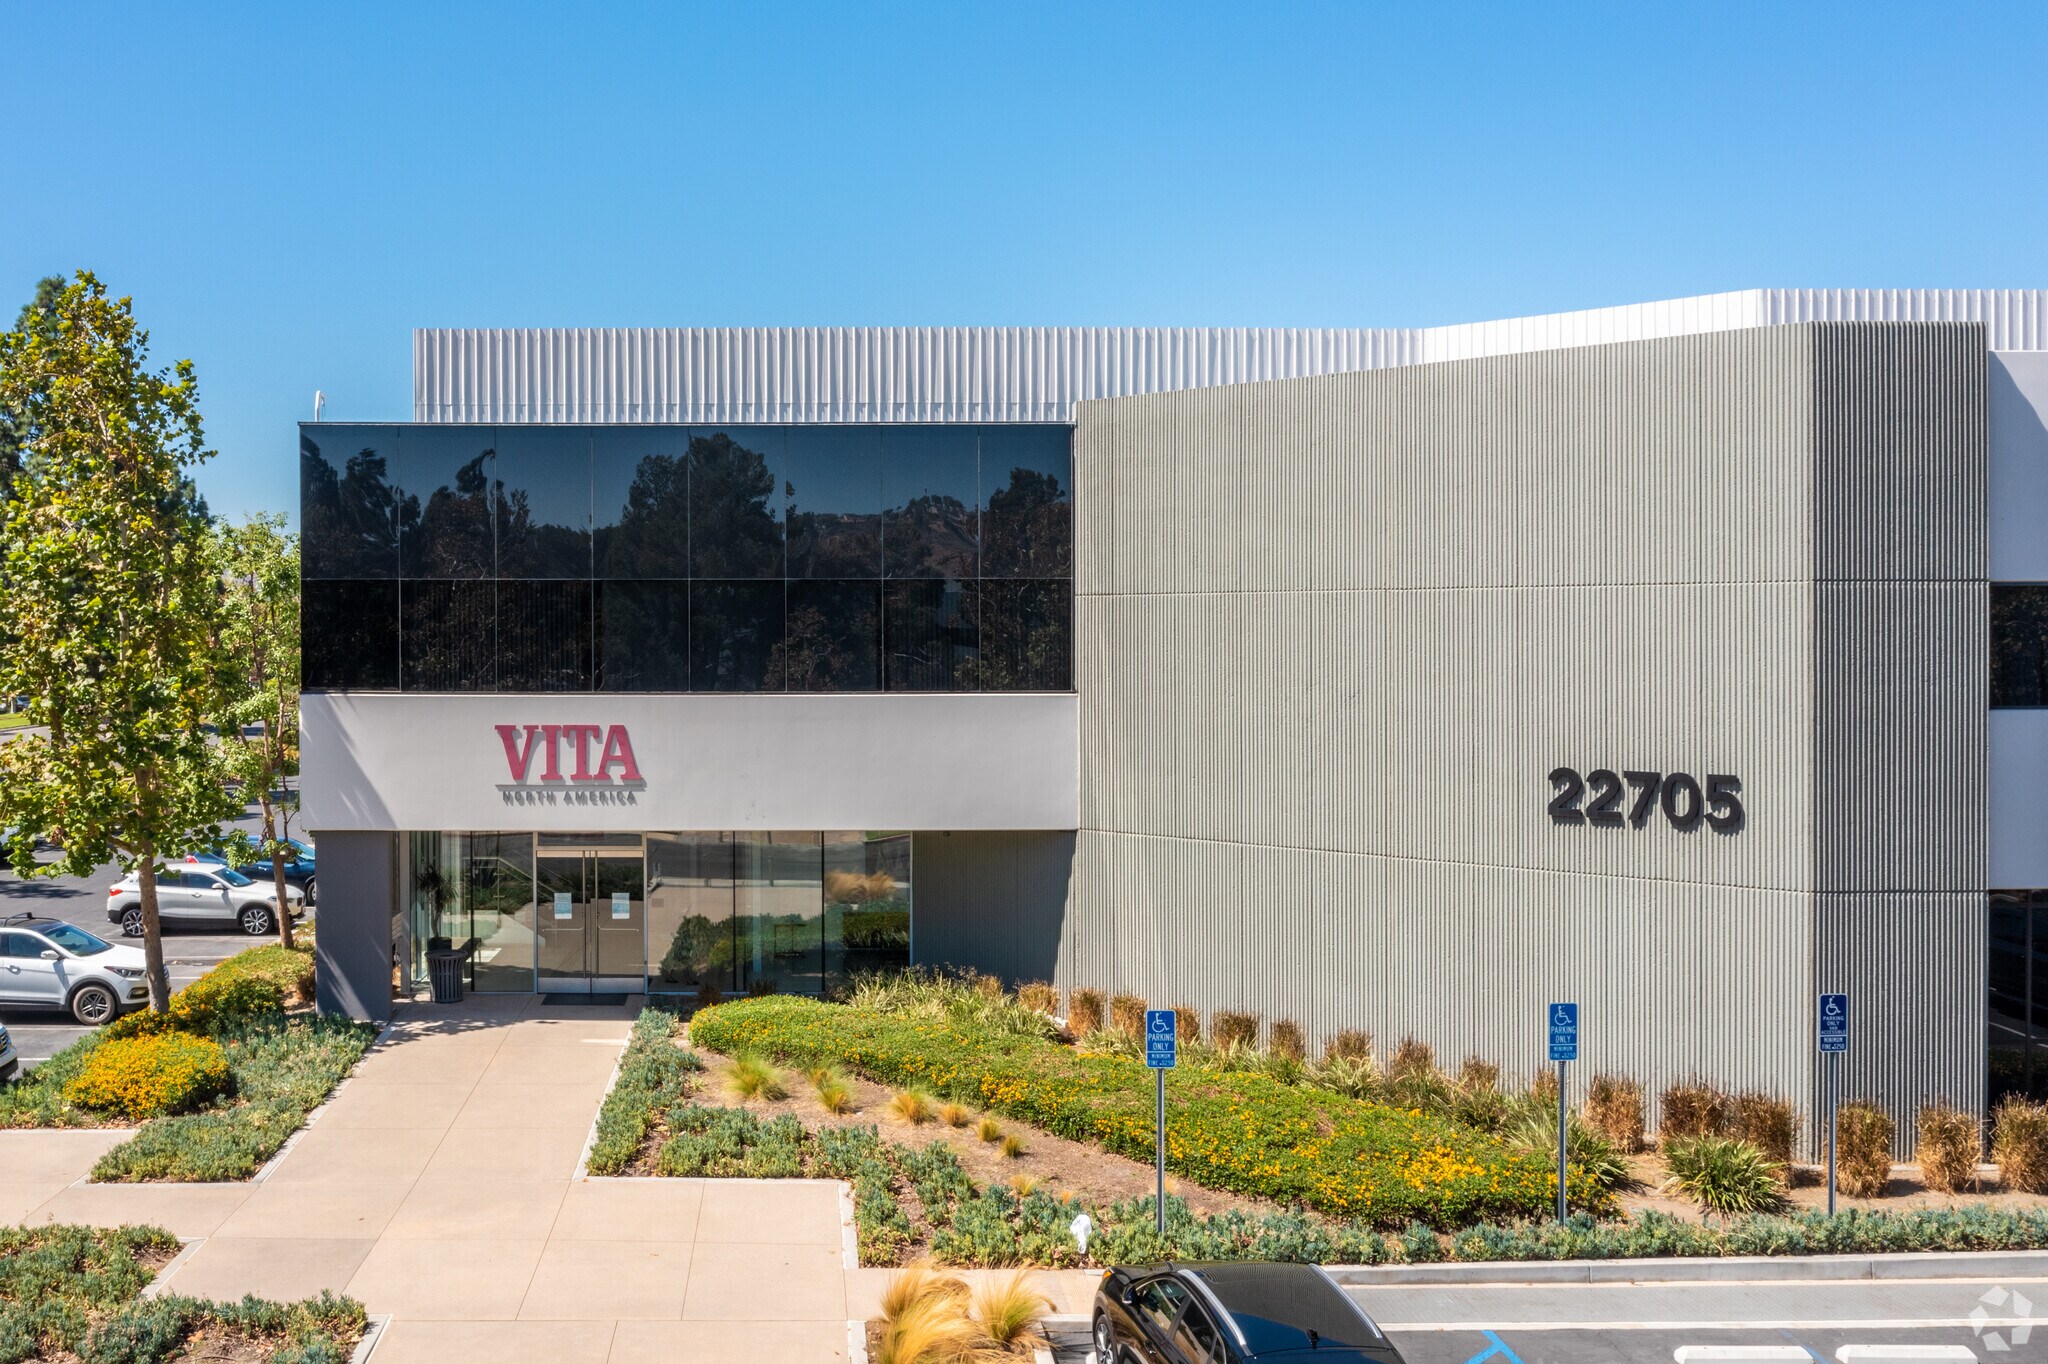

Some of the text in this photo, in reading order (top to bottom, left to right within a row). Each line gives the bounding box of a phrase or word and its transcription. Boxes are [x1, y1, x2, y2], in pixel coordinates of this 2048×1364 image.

[495, 724, 642, 781] VITA
[502, 790, 636, 803] NORTH AMERICA
[1548, 767, 1742, 829] 22705
[1550, 1025, 1576, 1034] PARKING
[1148, 1033, 1174, 1042] PARKING
[1555, 1035, 1571, 1044] ONLY
[1152, 1042, 1169, 1051] ONLY
